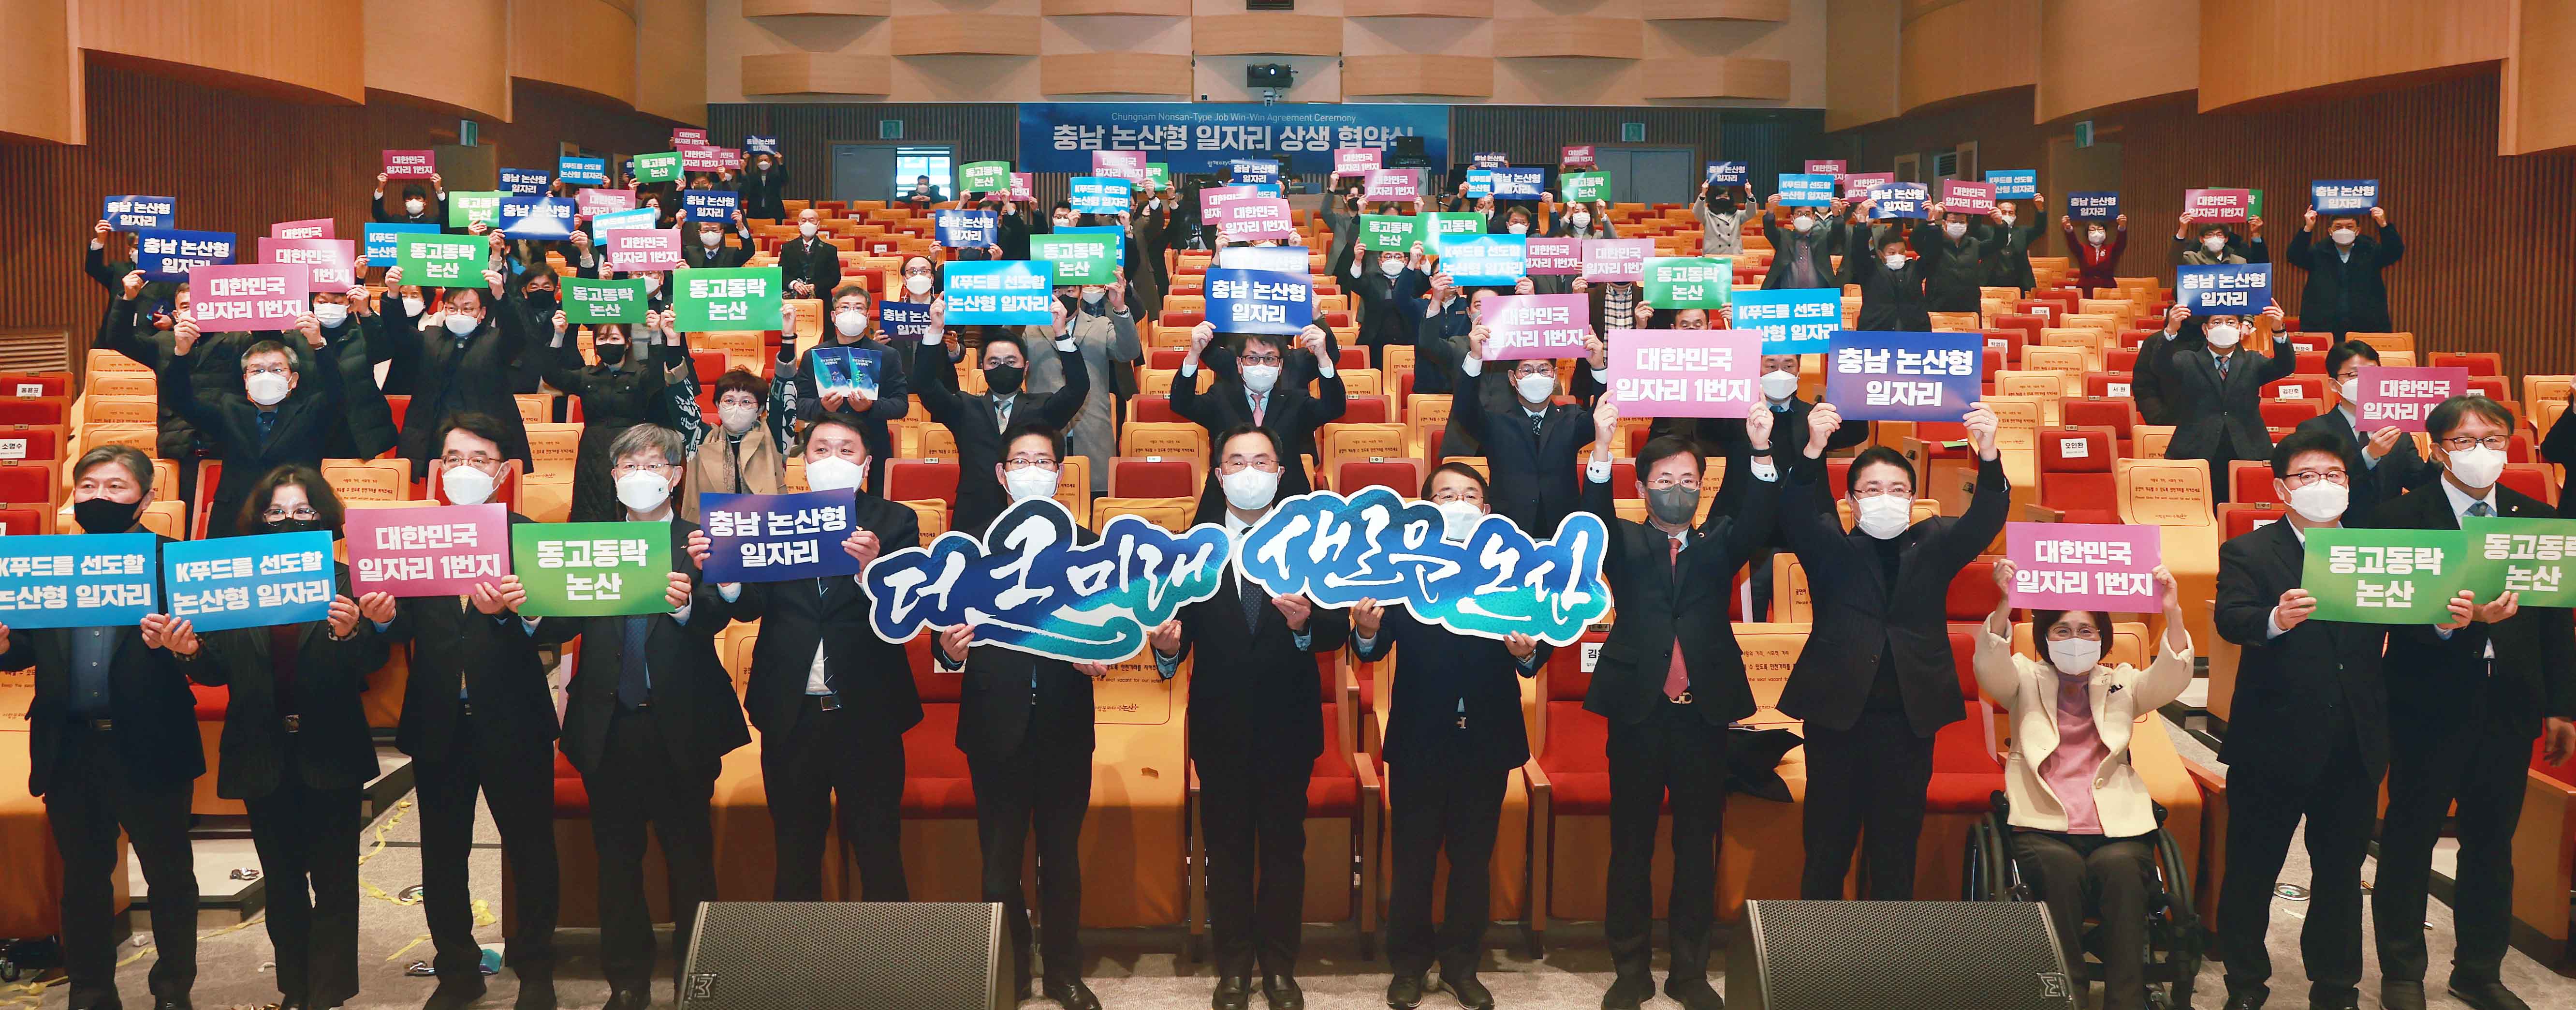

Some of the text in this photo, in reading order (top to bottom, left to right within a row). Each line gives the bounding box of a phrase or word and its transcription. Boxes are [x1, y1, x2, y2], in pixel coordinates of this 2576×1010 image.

[1112, 113, 1356, 123] Chungnam Nonsan-Type Job Win-Win Agreement Ceremony
[1053, 125, 1104, 150] 충남
[1112, 125, 1187, 150] 논산형
[1196, 125, 1271, 150] 일자리
[1280, 126, 1330, 151] 상생
[392, 156, 425, 164] 대한민국
[642, 158, 675, 168] 동고동락
[1343, 154, 1373, 163] 대한민국
[387, 165, 433, 174] 일자리 1번지
[650, 167, 668, 178] 논산
[1337, 164, 1360, 172] 일자리
[502, 174, 546, 184] 충남 논산형
[512, 184, 537, 193] 일자리
[1871, 189, 1924, 200] 충남 논산형
[1953, 187, 1986, 198] 대한민국
[2316, 186, 2374, 196] 충남 논산형
[687, 195, 734, 207] 충남 논산형
[1884, 201, 1914, 212] 일자리
[1946, 197, 1992, 209] 일자리 1번지
[2070, 197, 2117, 207] 충남 논산형
[2197, 195, 2237, 205] 대한민국
[2328, 198, 2361, 208] 일자리
[107, 202, 170, 214] 충남 논산형
[503, 205, 529, 217] 충남
[697, 208, 723, 217] 일자리
[1233, 206, 1278, 219] 대한민국
[2080, 207, 2106, 217] 일자리
[2190, 208, 2244, 218] 일자리 1번지
[120, 214, 156, 227] 일자리
[938, 216, 994, 229] 충남 논산형
[1226, 221, 1288, 232] 일자리 1번지
[1369, 221, 1413, 234] 동고동락
[951, 229, 982, 241] 일자리
[1379, 234, 1402, 246] 논산
[620, 237, 667, 249] 대한민국
[1044, 243, 1104, 258] 동고동락
[1529, 245, 1569, 256] 대한민국
[410, 243, 476, 259] 동고동락
[612, 251, 677, 263] 일자리 1번지
[1445, 245, 1520, 257] K푸드를 선도할
[426, 263, 459, 278] 논산
[1059, 260, 1090, 276] 논산
[1443, 262, 1523, 275] 논산형 일자리
[1553, 258, 1577, 268] 1번지
[951, 274, 1045, 290] K푸드를 선도할
[1657, 267, 1719, 282] 동고동락
[2183, 273, 2266, 289] 충남 논산형
[211, 278, 285, 296] 대한민국
[572, 286, 634, 301] 동고동락
[689, 279, 767, 299] 동고동락
[1212, 280, 1306, 301] 충남 논산형
[1672, 284, 1703, 300] 논산
[948, 296, 1048, 312] 논산형 일자리
[2201, 291, 2248, 307] 일자리
[197, 300, 302, 320] 일자리 1번지
[589, 304, 621, 317] 논산
[709, 301, 747, 320] 논산
[883, 309, 906, 322] 충남
[1232, 304, 1285, 323] 일자리
[1501, 307, 1569, 326] 대한민국
[1740, 303, 1834, 319] K푸드를 선도할
[1489, 328, 1583, 349] 일자리 1번지
[1790, 324, 1838, 341] 일자리
[1637, 348, 1732, 371] 대한민국
[1838, 347, 1973, 376] 충남 논산형
[1616, 378, 1751, 402] 일자리 1번지
[1866, 382, 1942, 406] 일자리
[2380, 380, 2450, 398] 대한민국
[2363, 404, 2417, 420] 일자리
[709, 505, 846, 536] 충남 논산형
[376, 523, 478, 550] 대한민국
[537, 539, 648, 568] 동고동락
[740, 540, 819, 567] 일자리
[2034, 540, 2131, 565] 대한민국
[0, 554, 145, 577] K푸드를 선도할
[176, 551, 323, 582] K푸드를 선도할
[358, 554, 500, 582] 일자리 1번지
[1258, 504, 1591, 625] 새로운 논산
[2329, 546, 2444, 575] 동고동락
[883, 515, 1213, 645] 더 큰 미래
[2016, 570, 2152, 596] 일자리 1번지
[2505, 565, 2561, 592] 논산
[567, 574, 622, 600] 논산
[2356, 580, 2415, 608] 논산
[75, 584, 150, 608] 일자리
[174, 579, 330, 615] 논산형 일자리
